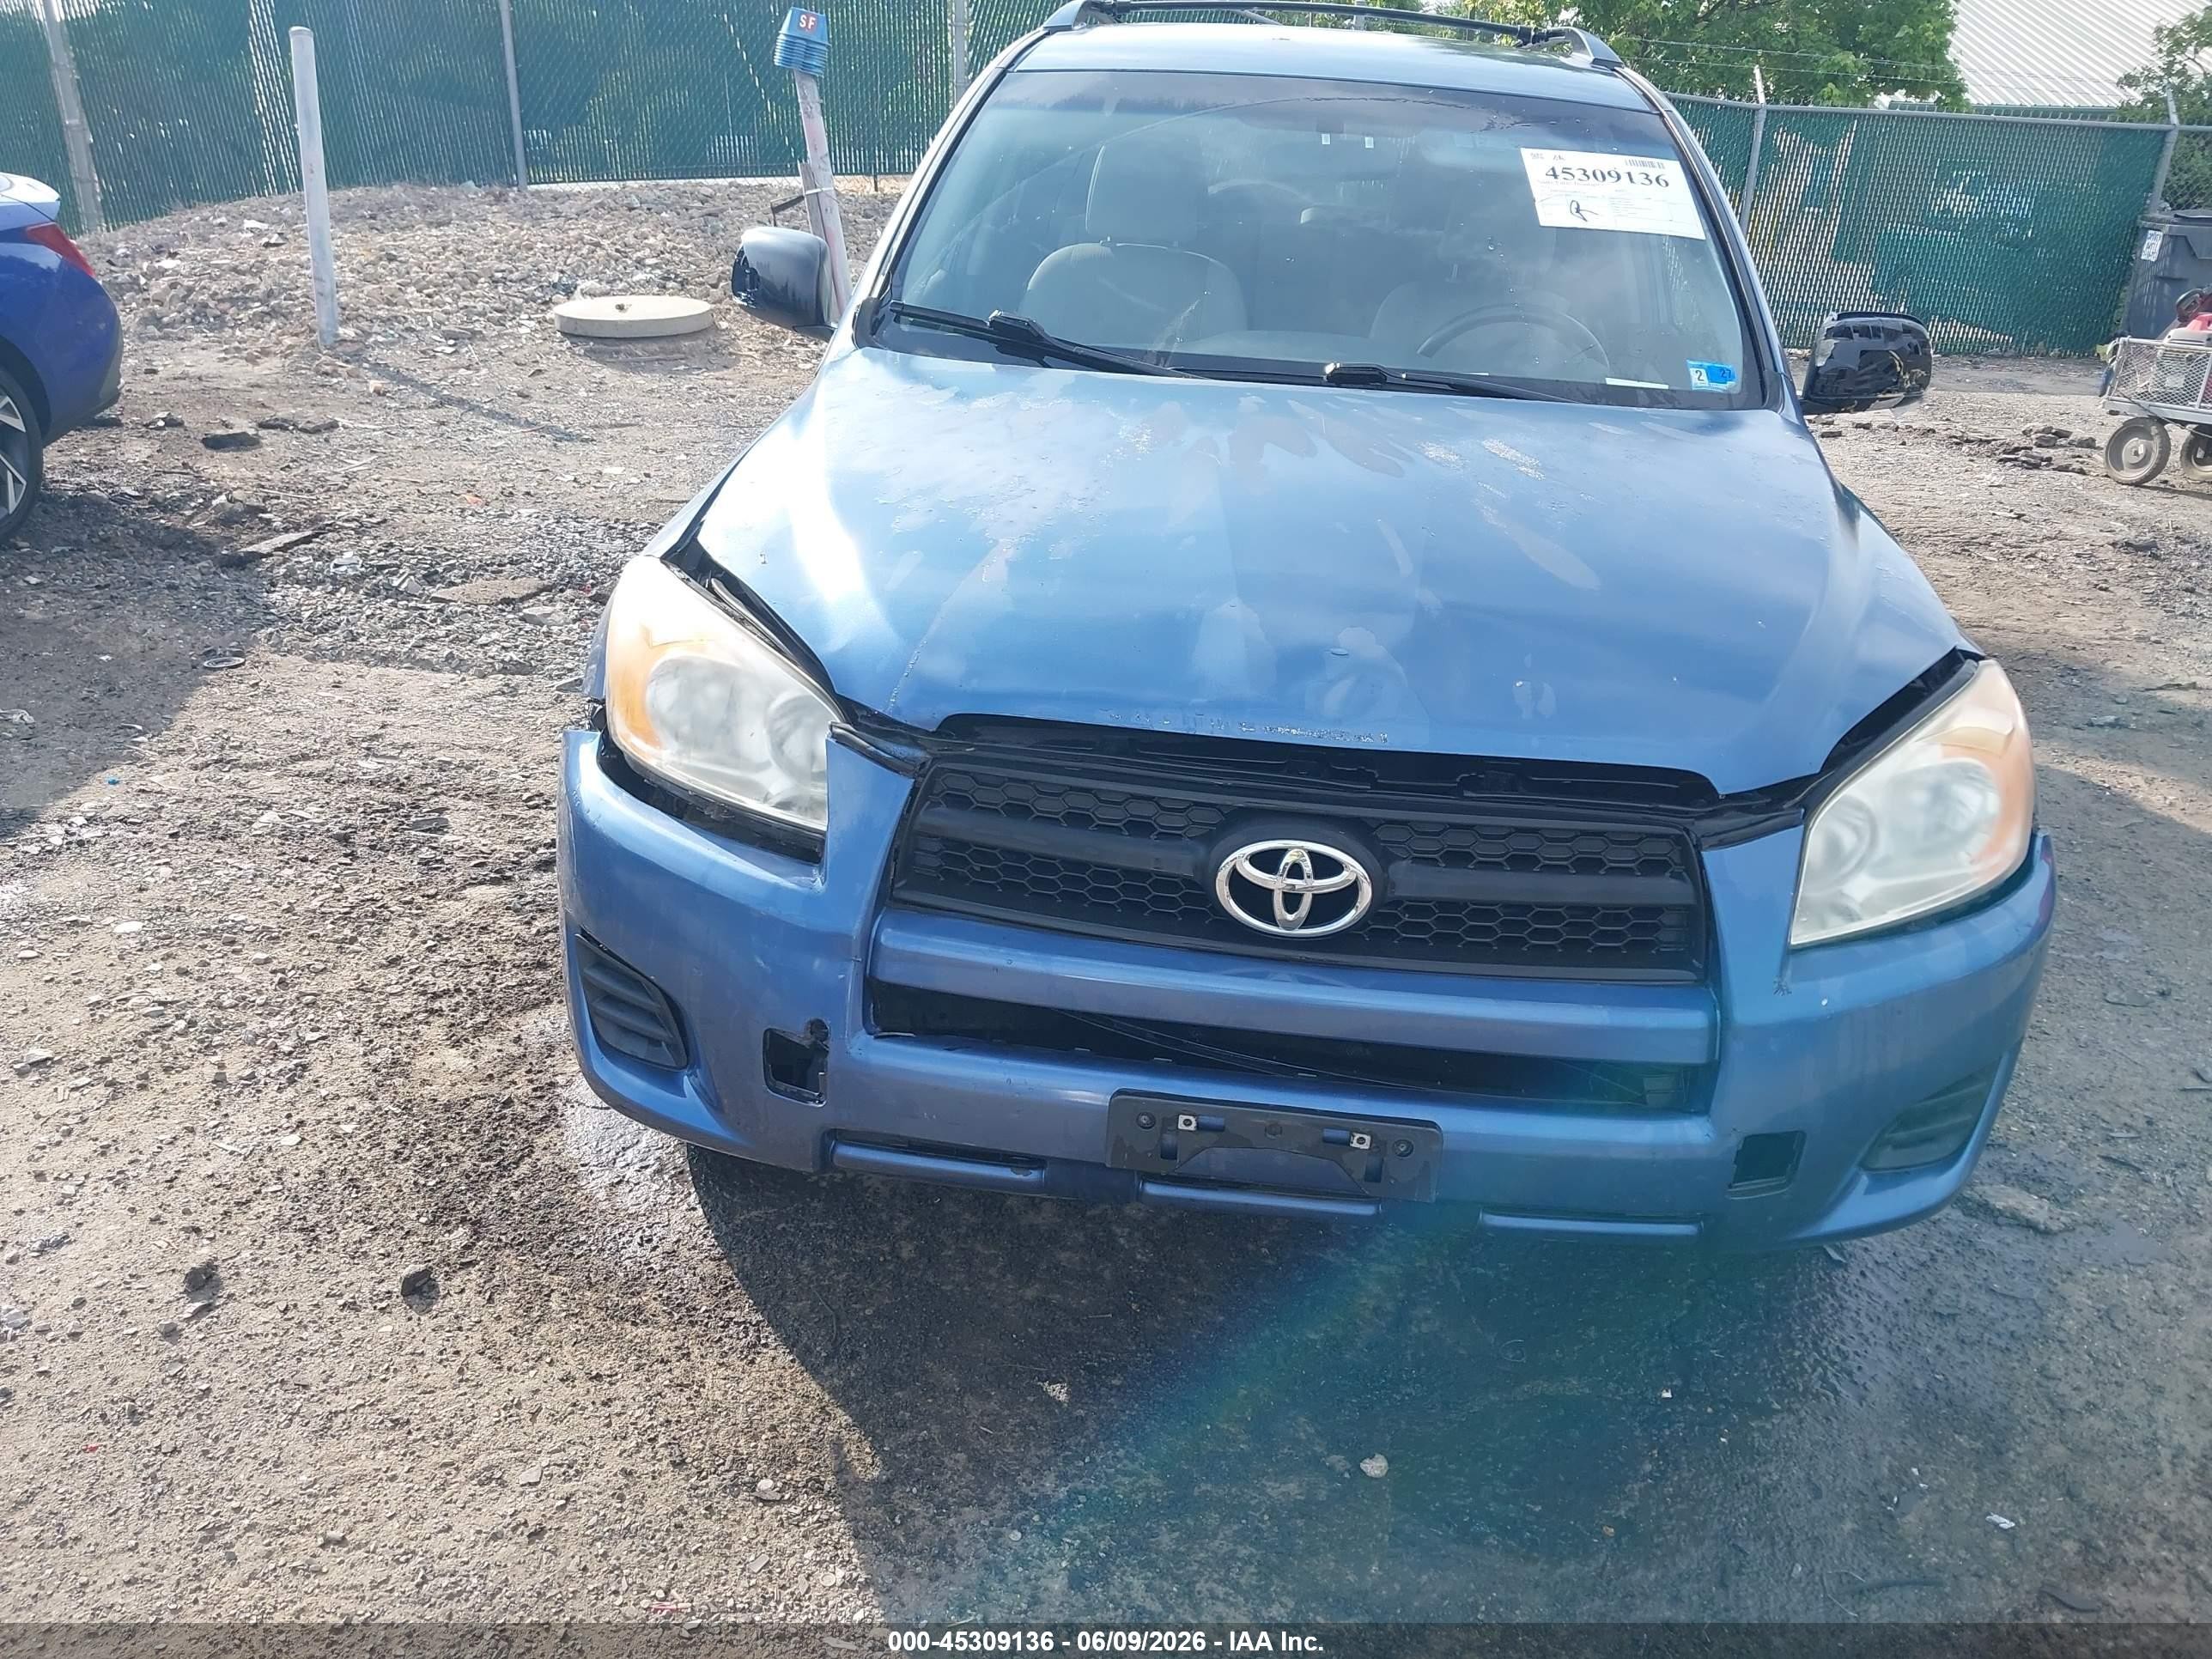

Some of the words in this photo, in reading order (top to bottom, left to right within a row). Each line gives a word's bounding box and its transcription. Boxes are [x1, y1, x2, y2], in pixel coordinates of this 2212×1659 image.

[799, 14, 817, 29] SF
[1545, 165, 1670, 188] 45309136
[1695, 369, 1705, 382] 2
[1719, 368, 1732, 379] 27
